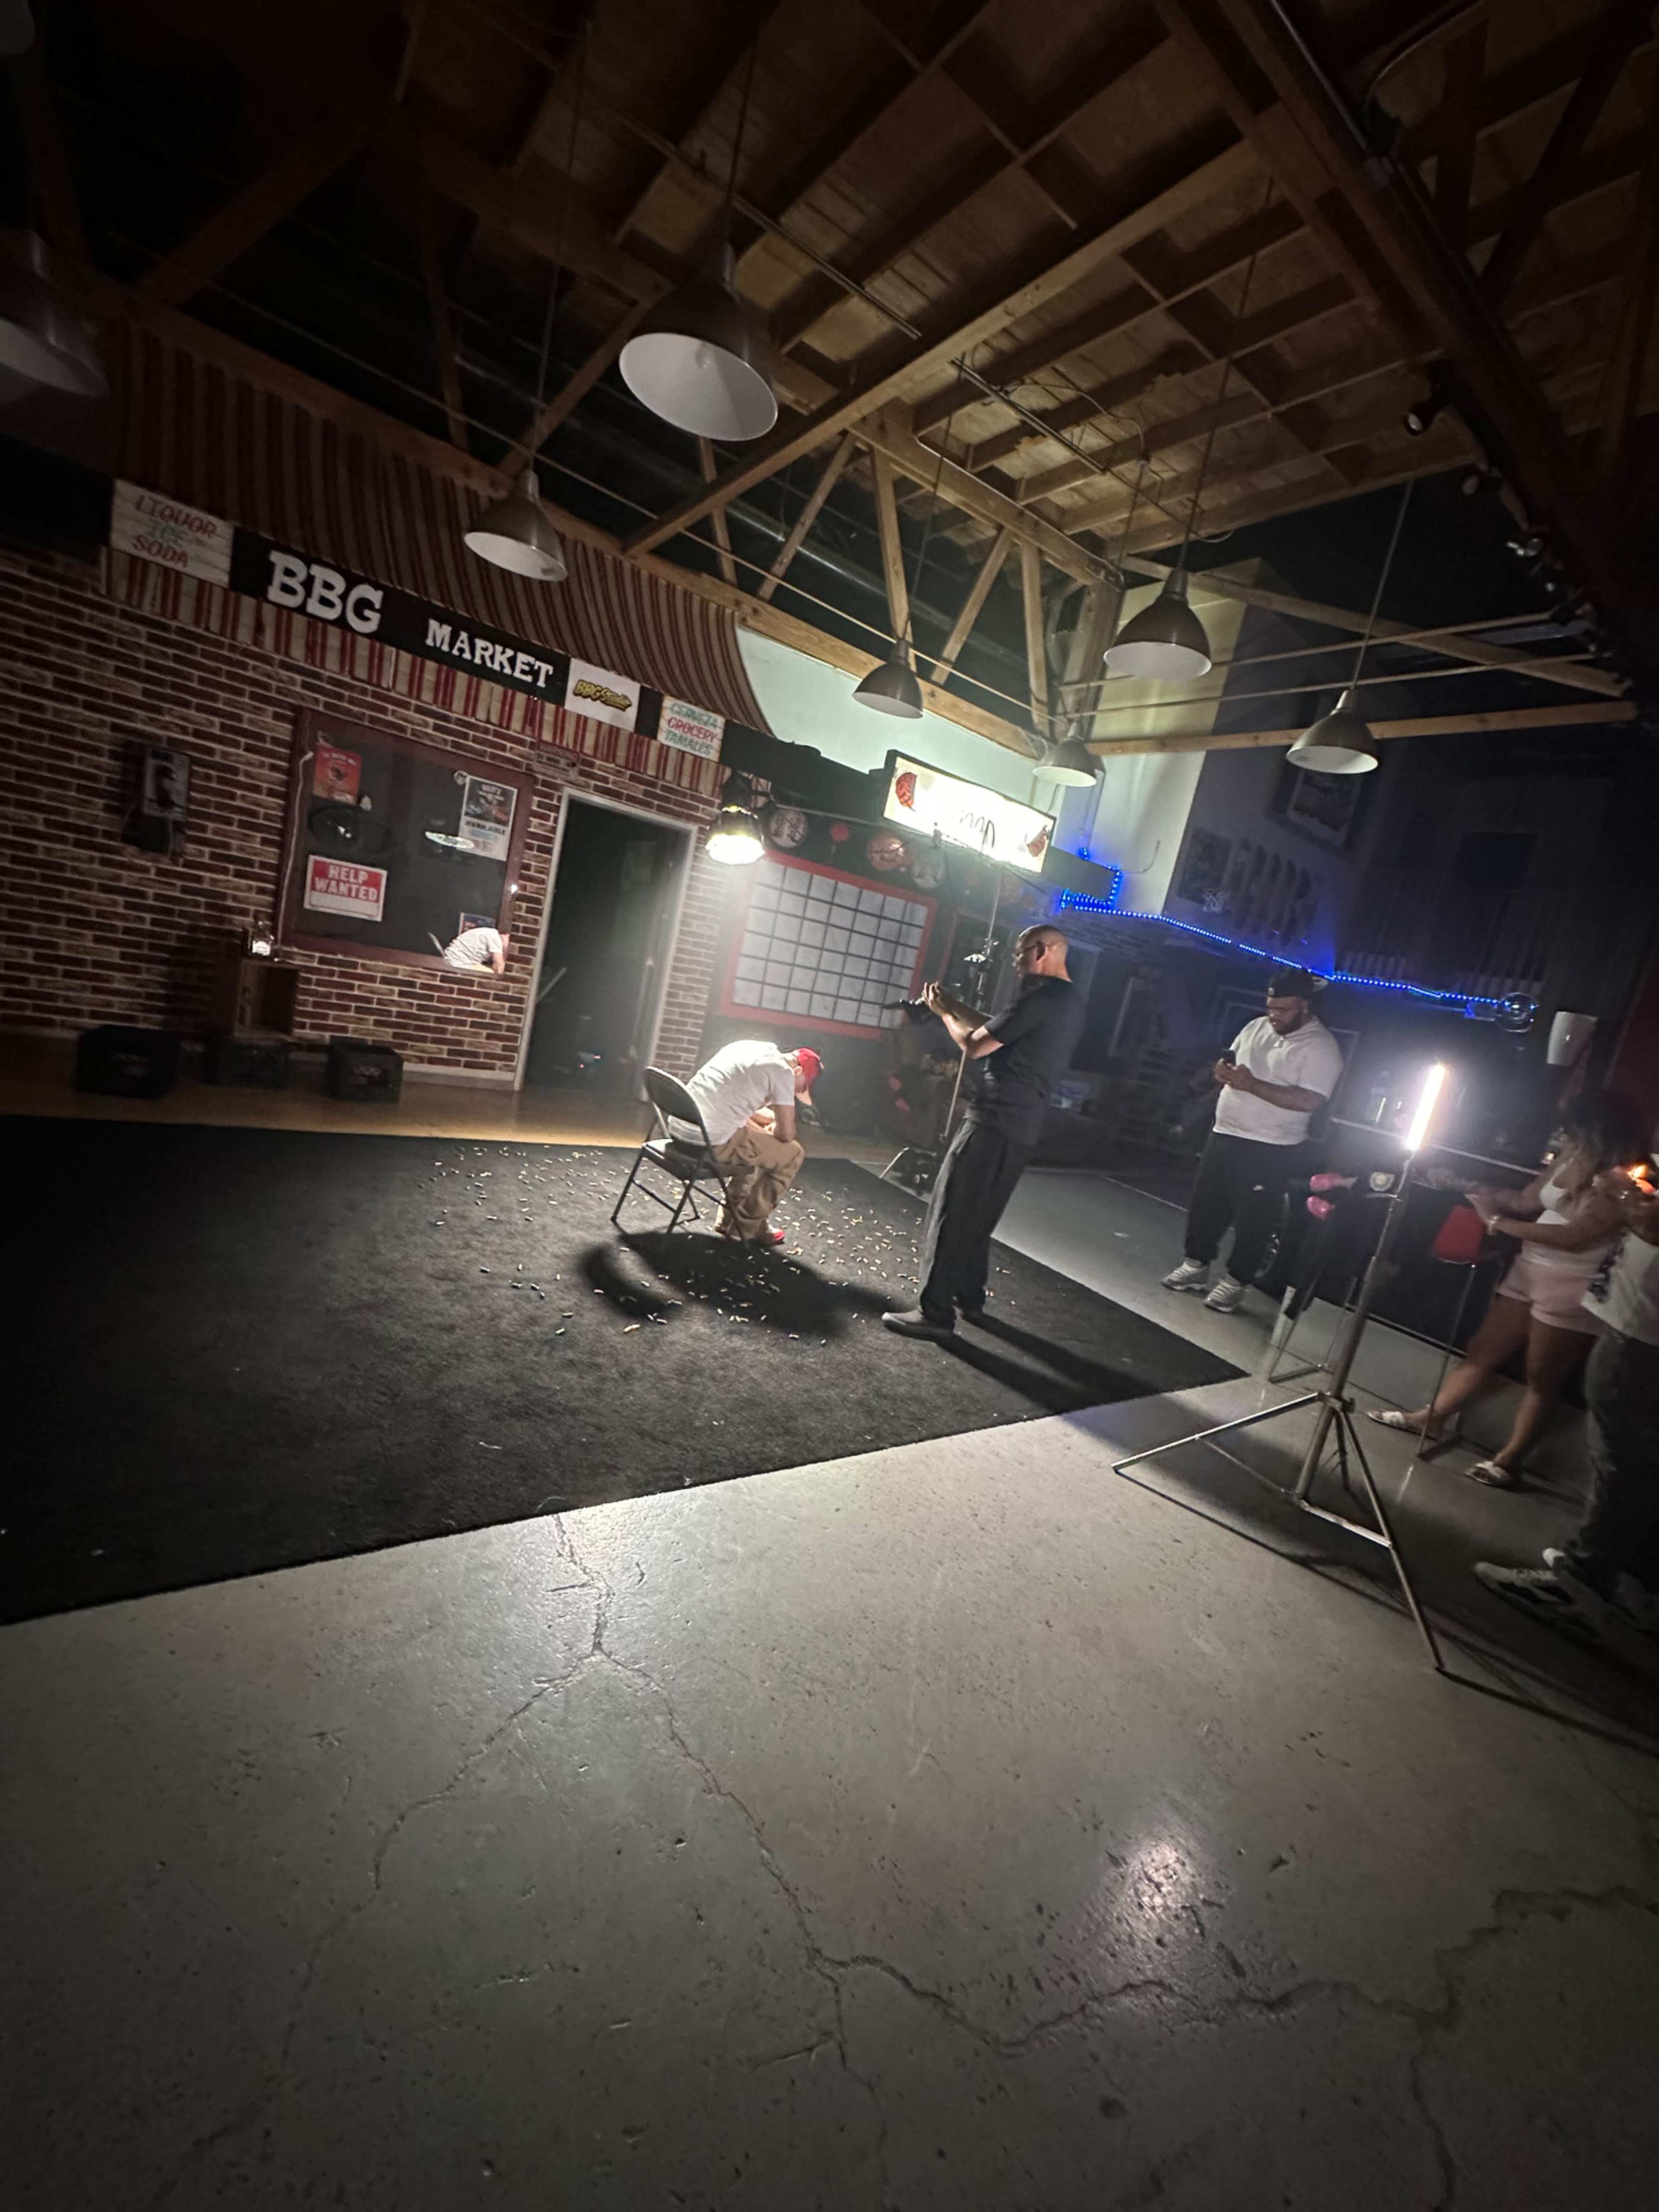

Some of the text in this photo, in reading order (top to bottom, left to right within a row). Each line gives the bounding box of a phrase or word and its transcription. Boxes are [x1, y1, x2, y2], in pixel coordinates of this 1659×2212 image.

[136, 495, 216, 538] LIQUOR
[132, 534, 189, 568] SODA
[267, 550, 553, 689] BBG MARKET
[573, 679, 603, 701] BBG
[664, 729, 713, 756] TAMALES
[668, 717, 720, 743] GROCERY
[328, 864, 369, 884] HELP
[315, 877, 378, 903] WANTED
